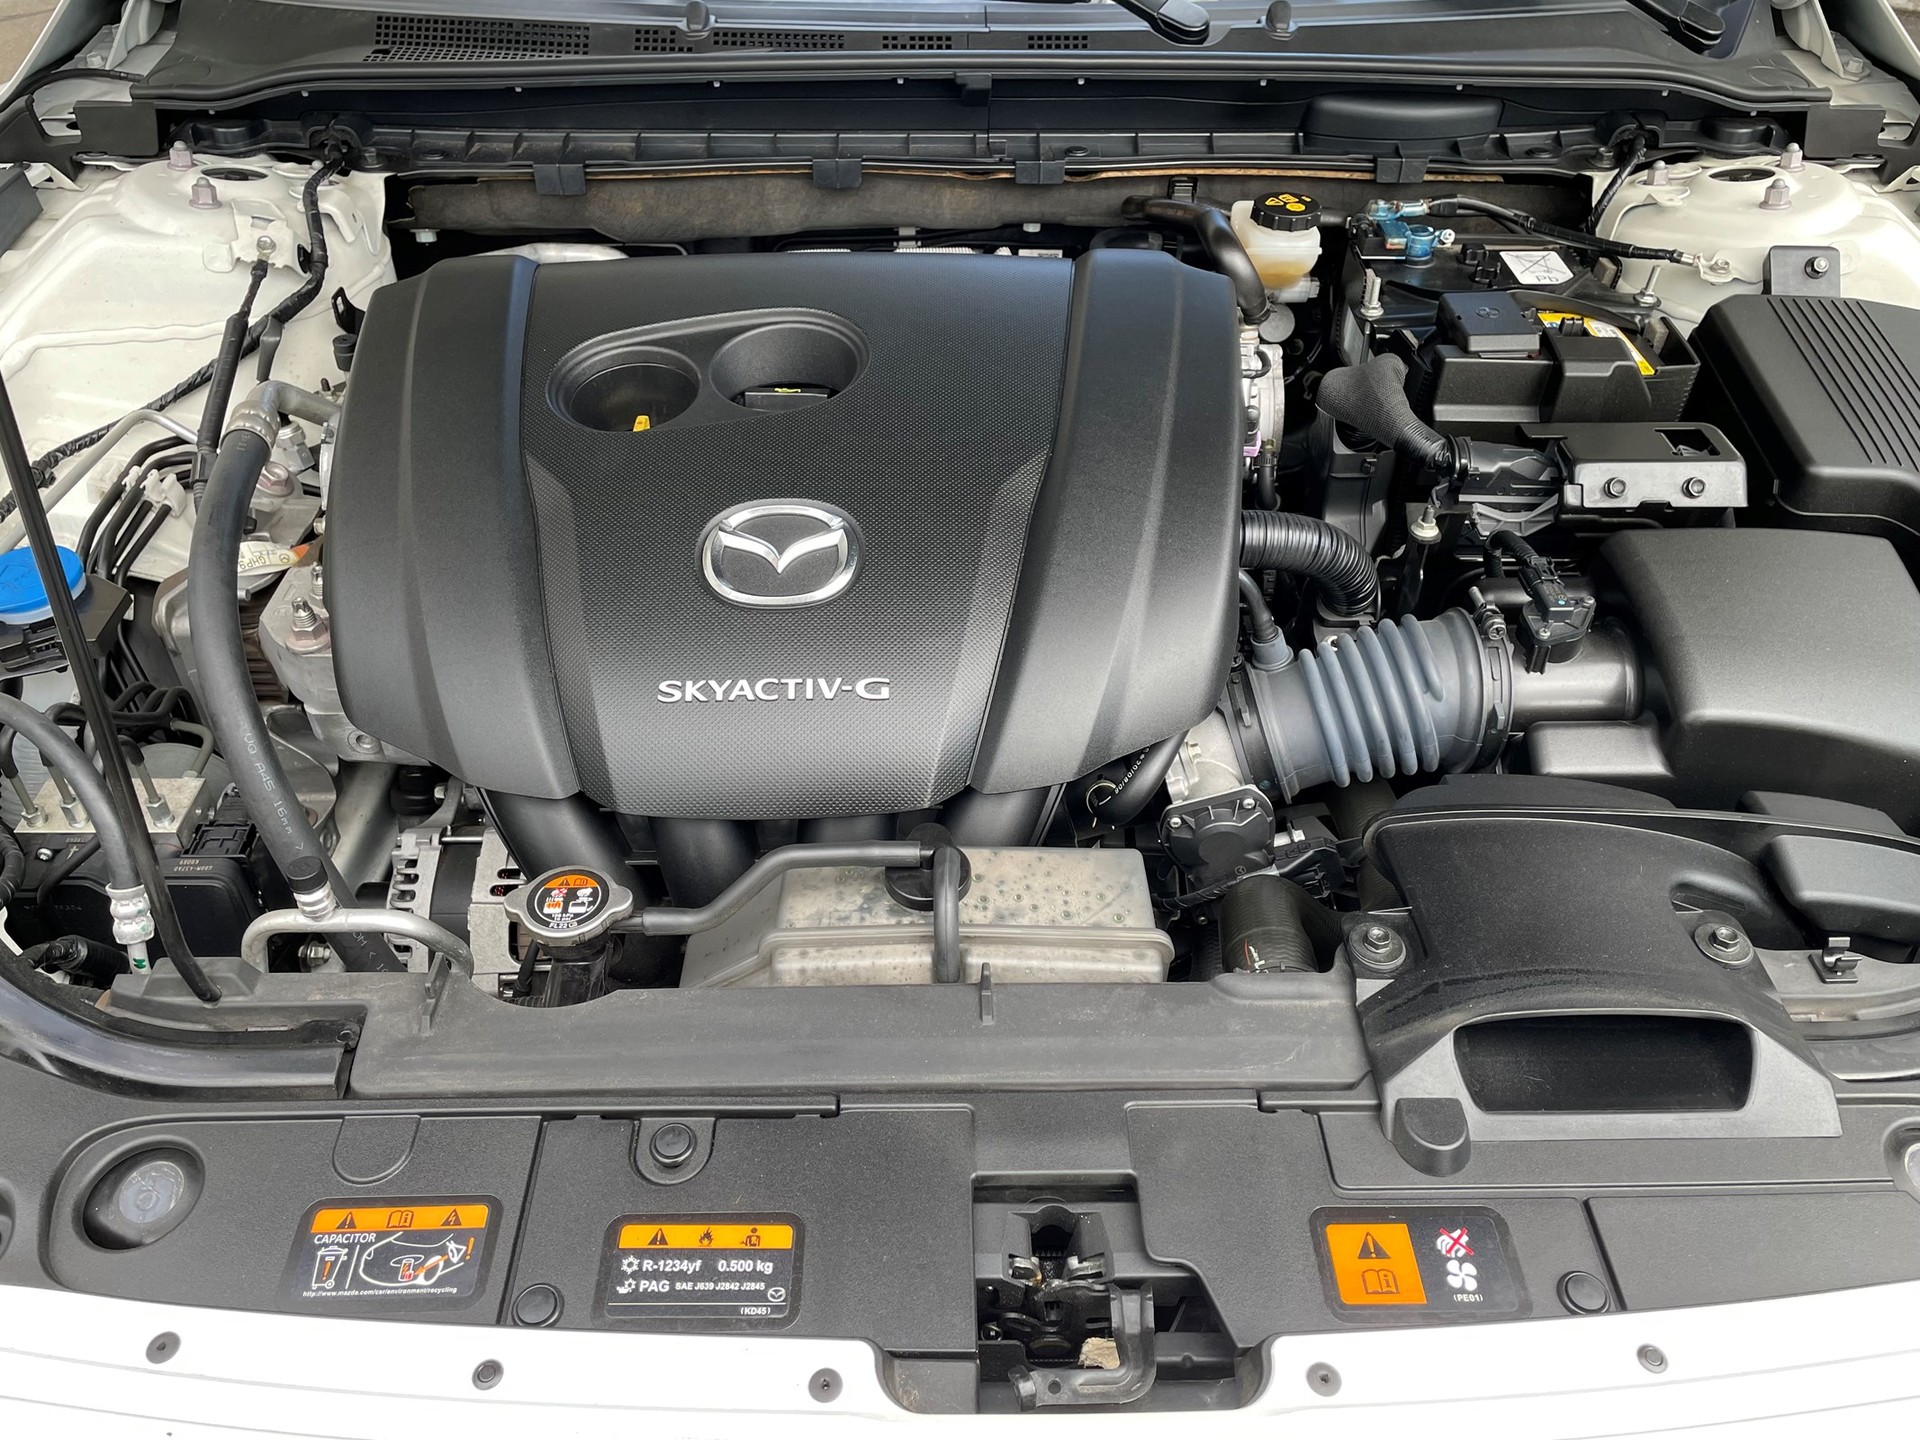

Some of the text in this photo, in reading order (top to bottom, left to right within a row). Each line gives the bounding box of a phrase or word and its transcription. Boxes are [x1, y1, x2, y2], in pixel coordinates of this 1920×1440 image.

[1535, 274, 1559, 282] Pb
[657, 677, 891, 702] SKYACTIV-G
[314, 1233, 376, 1244] CAPACITOR
[642, 1259, 774, 1275] R-1234yf 0.500 kg
[639, 1280, 765, 1292] PAG SAE J639 J2842 J2845
[740, 1306, 771, 1315] (KD45)
